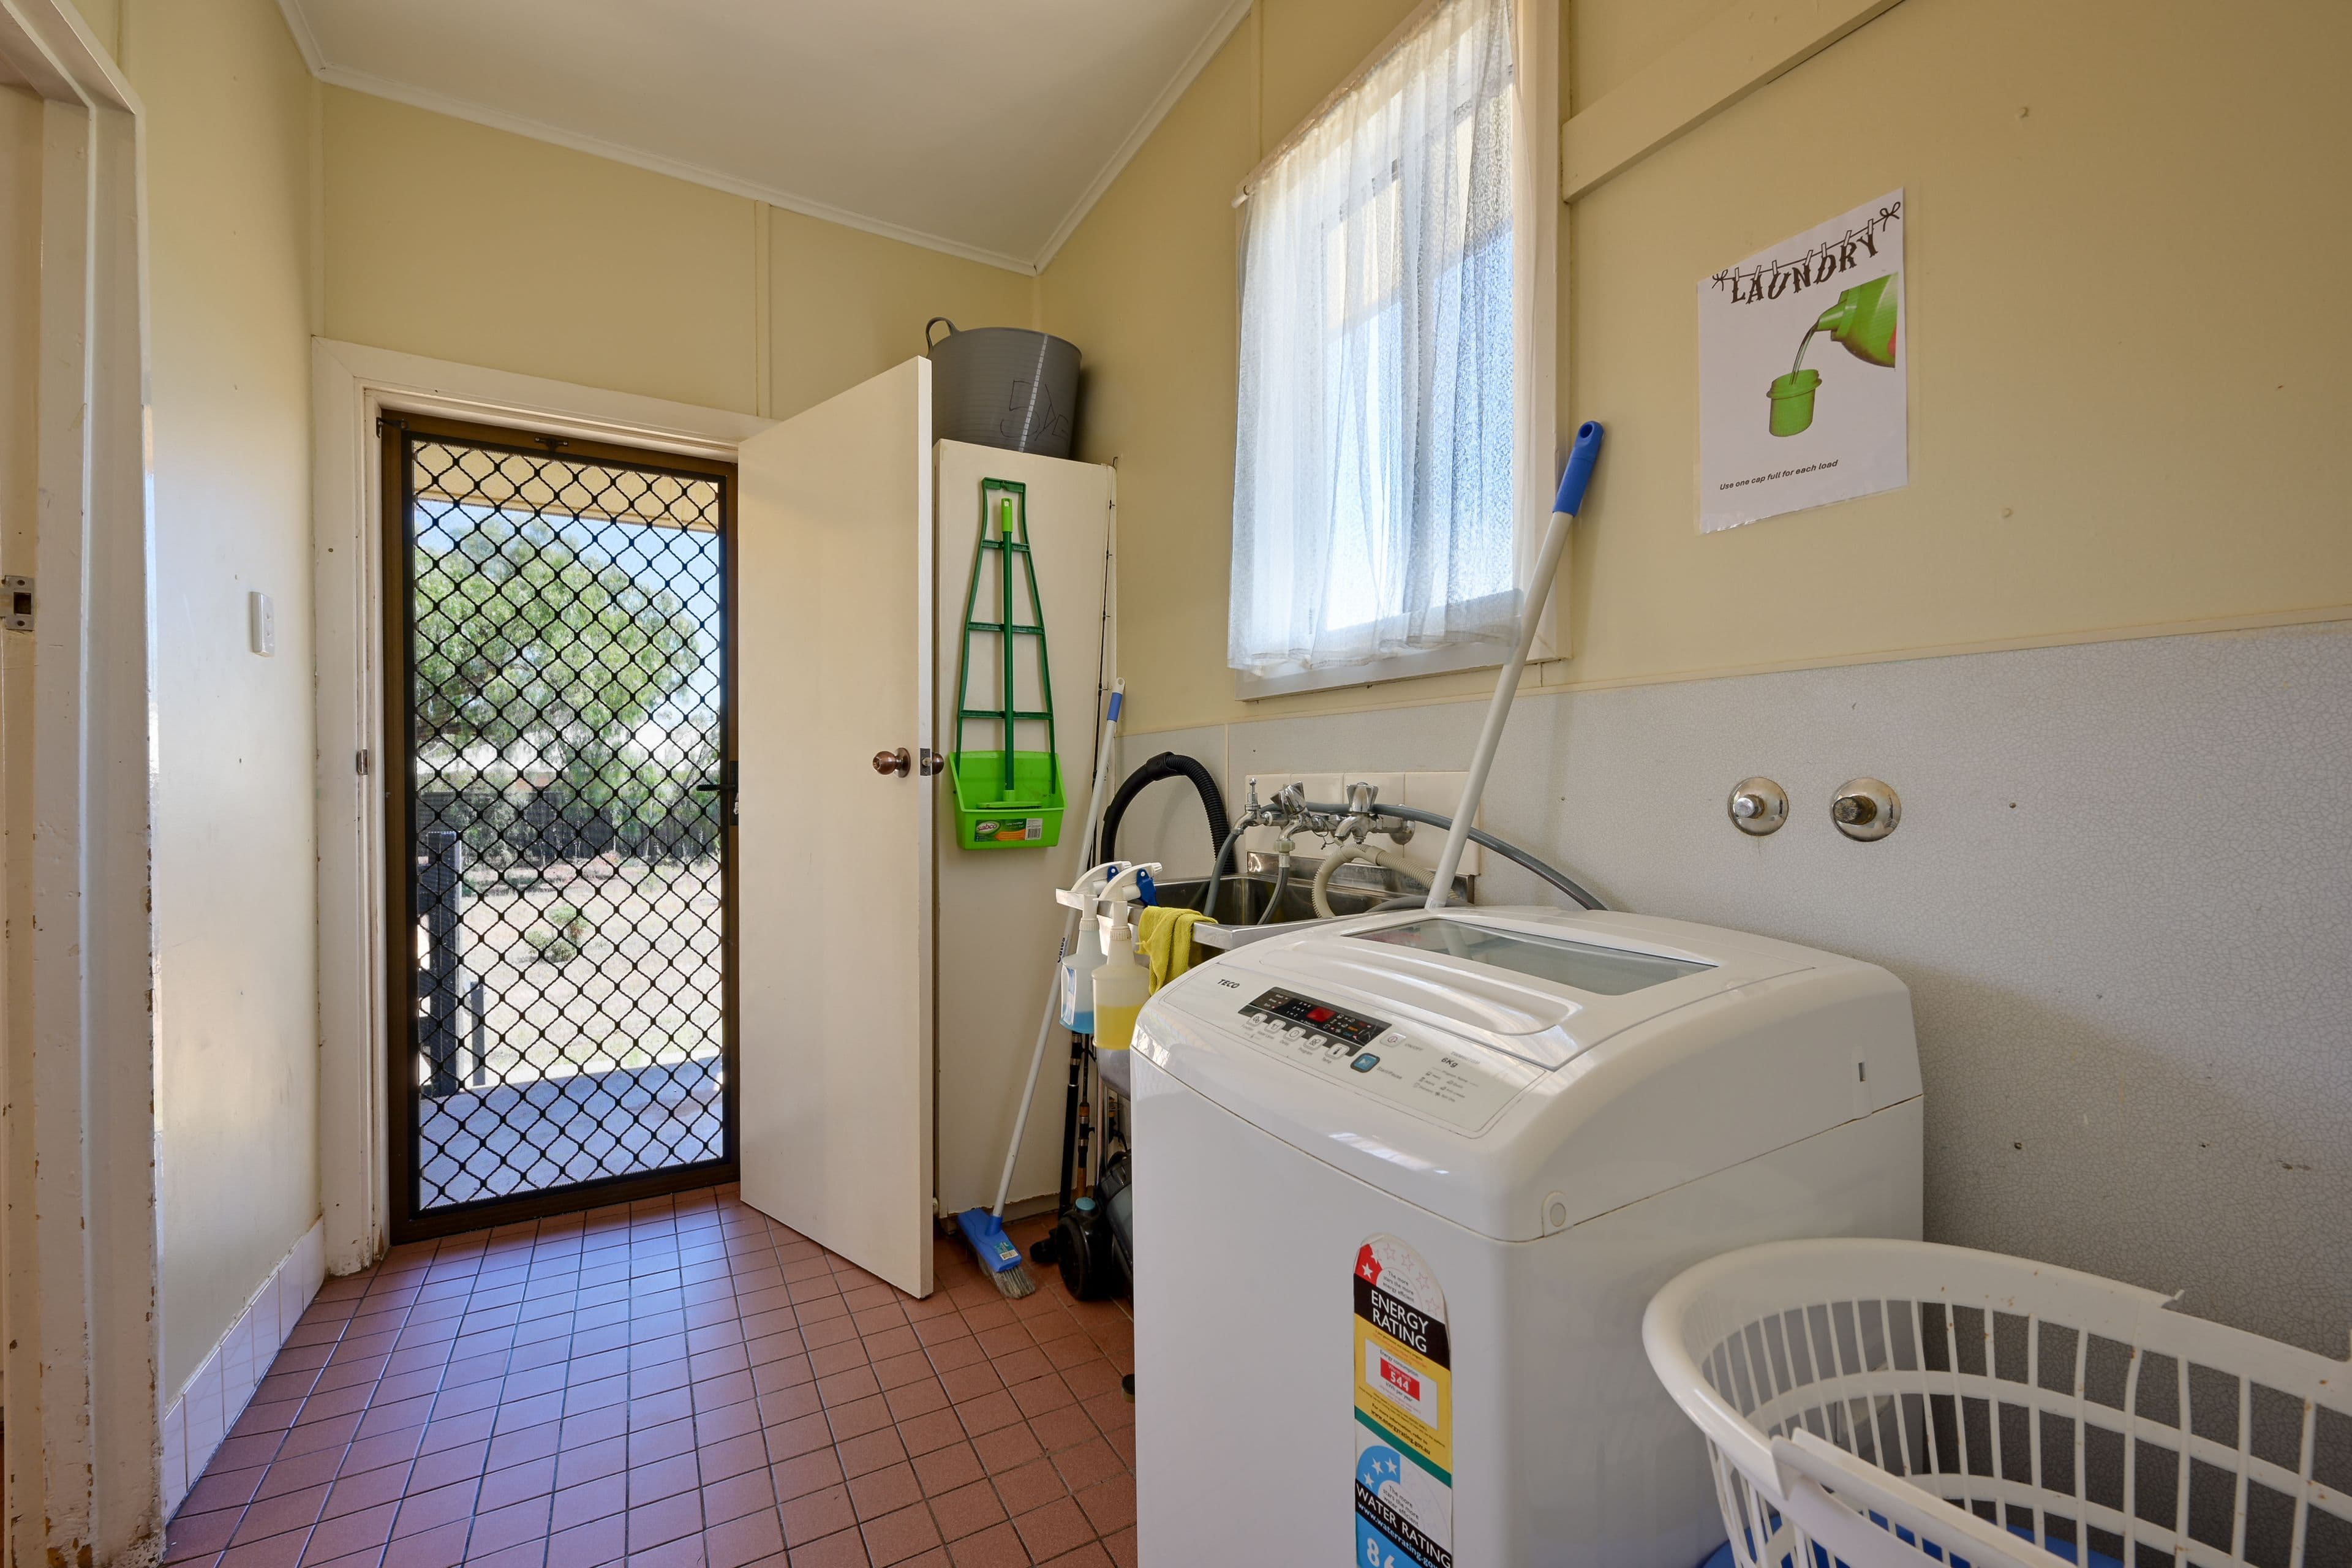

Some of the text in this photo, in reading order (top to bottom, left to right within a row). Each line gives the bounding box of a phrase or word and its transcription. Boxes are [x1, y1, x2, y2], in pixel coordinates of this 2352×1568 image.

[1731, 228, 1879, 304] LAUNDRY
[1735, 479, 1750, 488] one
[1751, 475, 1766, 484] cap
[1767, 471, 1781, 481] full
[1782, 469, 1795, 478] for
[1795, 464, 1817, 475] each
[1818, 459, 1839, 470] load
[1217, 979, 1240, 989] TECO
[1441, 1057, 1458, 1068] 6Kg
[1387, 1270, 1409, 1286] The more
[1402, 1286, 1414, 1296] more
[1371, 1289, 1429, 1335] ENERGY
[1373, 1308, 1427, 1353] RATING
[1390, 1371, 1409, 1393] 544
[1383, 1489, 1395, 1501] stars
[1405, 1506, 1419, 1520] more
[1389, 1484, 1413, 1509] The more
[1355, 1482, 1451, 1568] WATER RATING
[1384, 1496, 1419, 1528] water efficient
